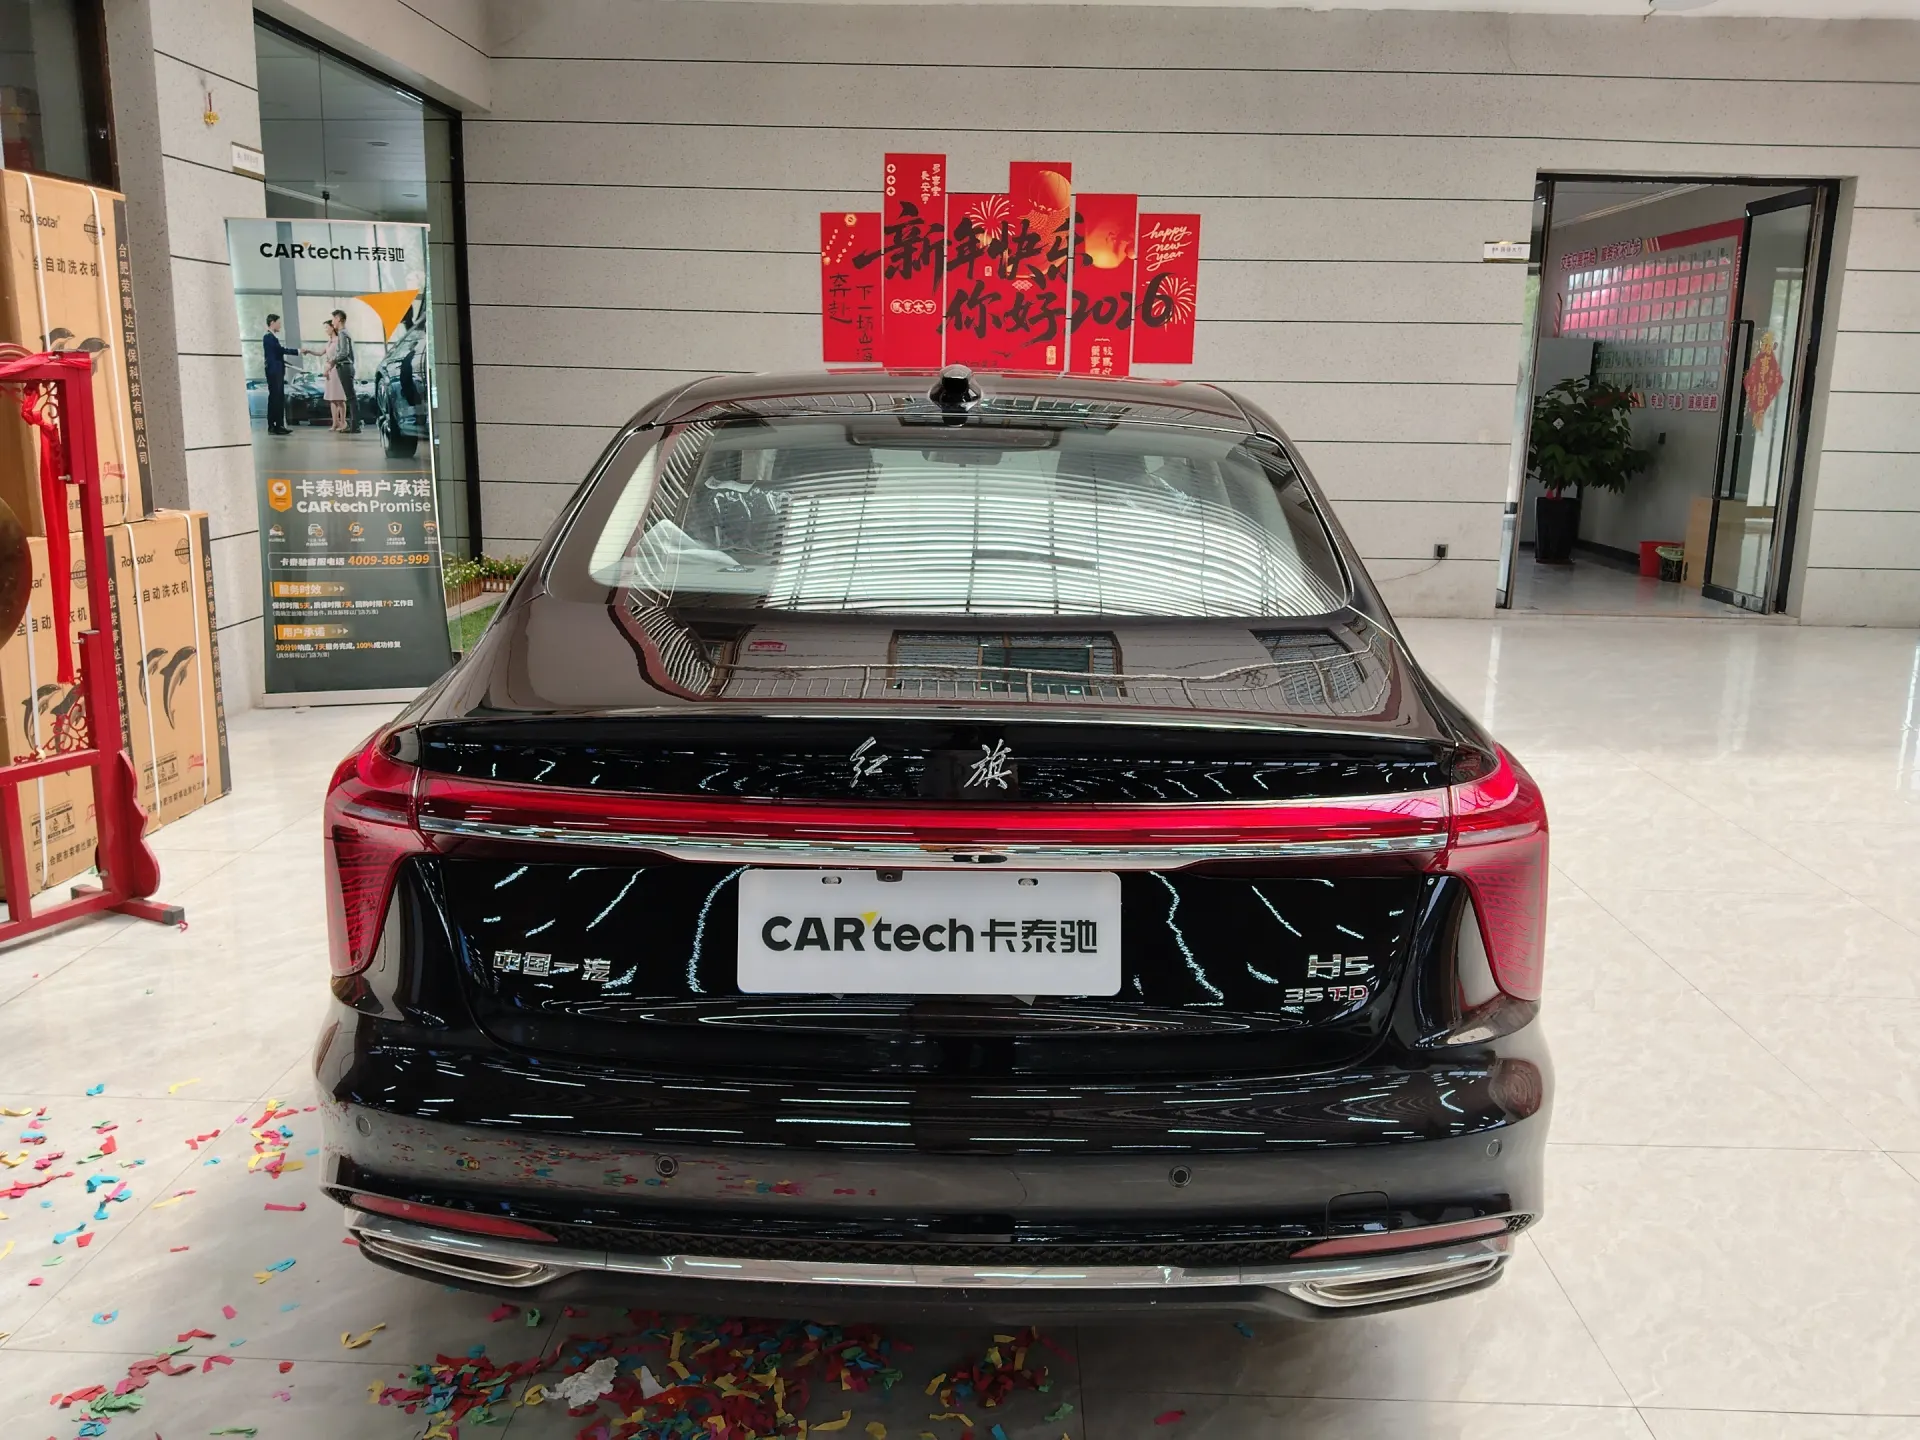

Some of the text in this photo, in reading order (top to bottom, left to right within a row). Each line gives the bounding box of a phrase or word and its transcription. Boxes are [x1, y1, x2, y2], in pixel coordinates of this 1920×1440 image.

[1142, 222, 1192, 242] happy
[354, 246, 405, 262] 卡泰驰
[849, 200, 1094, 296] 新年快乐
[1147, 241, 1192, 253] new
[33, 254, 100, 277] 全自动洗衣机
[1146, 251, 1184, 271] year
[118, 243, 149, 465] 合肥荣事达环保科技有限公司
[296, 479, 431, 498] 卡泰驰用户承诺
[370, 500, 431, 513] Promise
[348, 554, 430, 566] 4009-365-999
[17, 607, 88, 637] 全自动衣机
[283, 626, 326, 637] 用户承诺
[980, 919, 1097, 953] 卡泰驰
[493, 949, 611, 982] 中国一汽
[1307, 953, 1370, 978] H5
